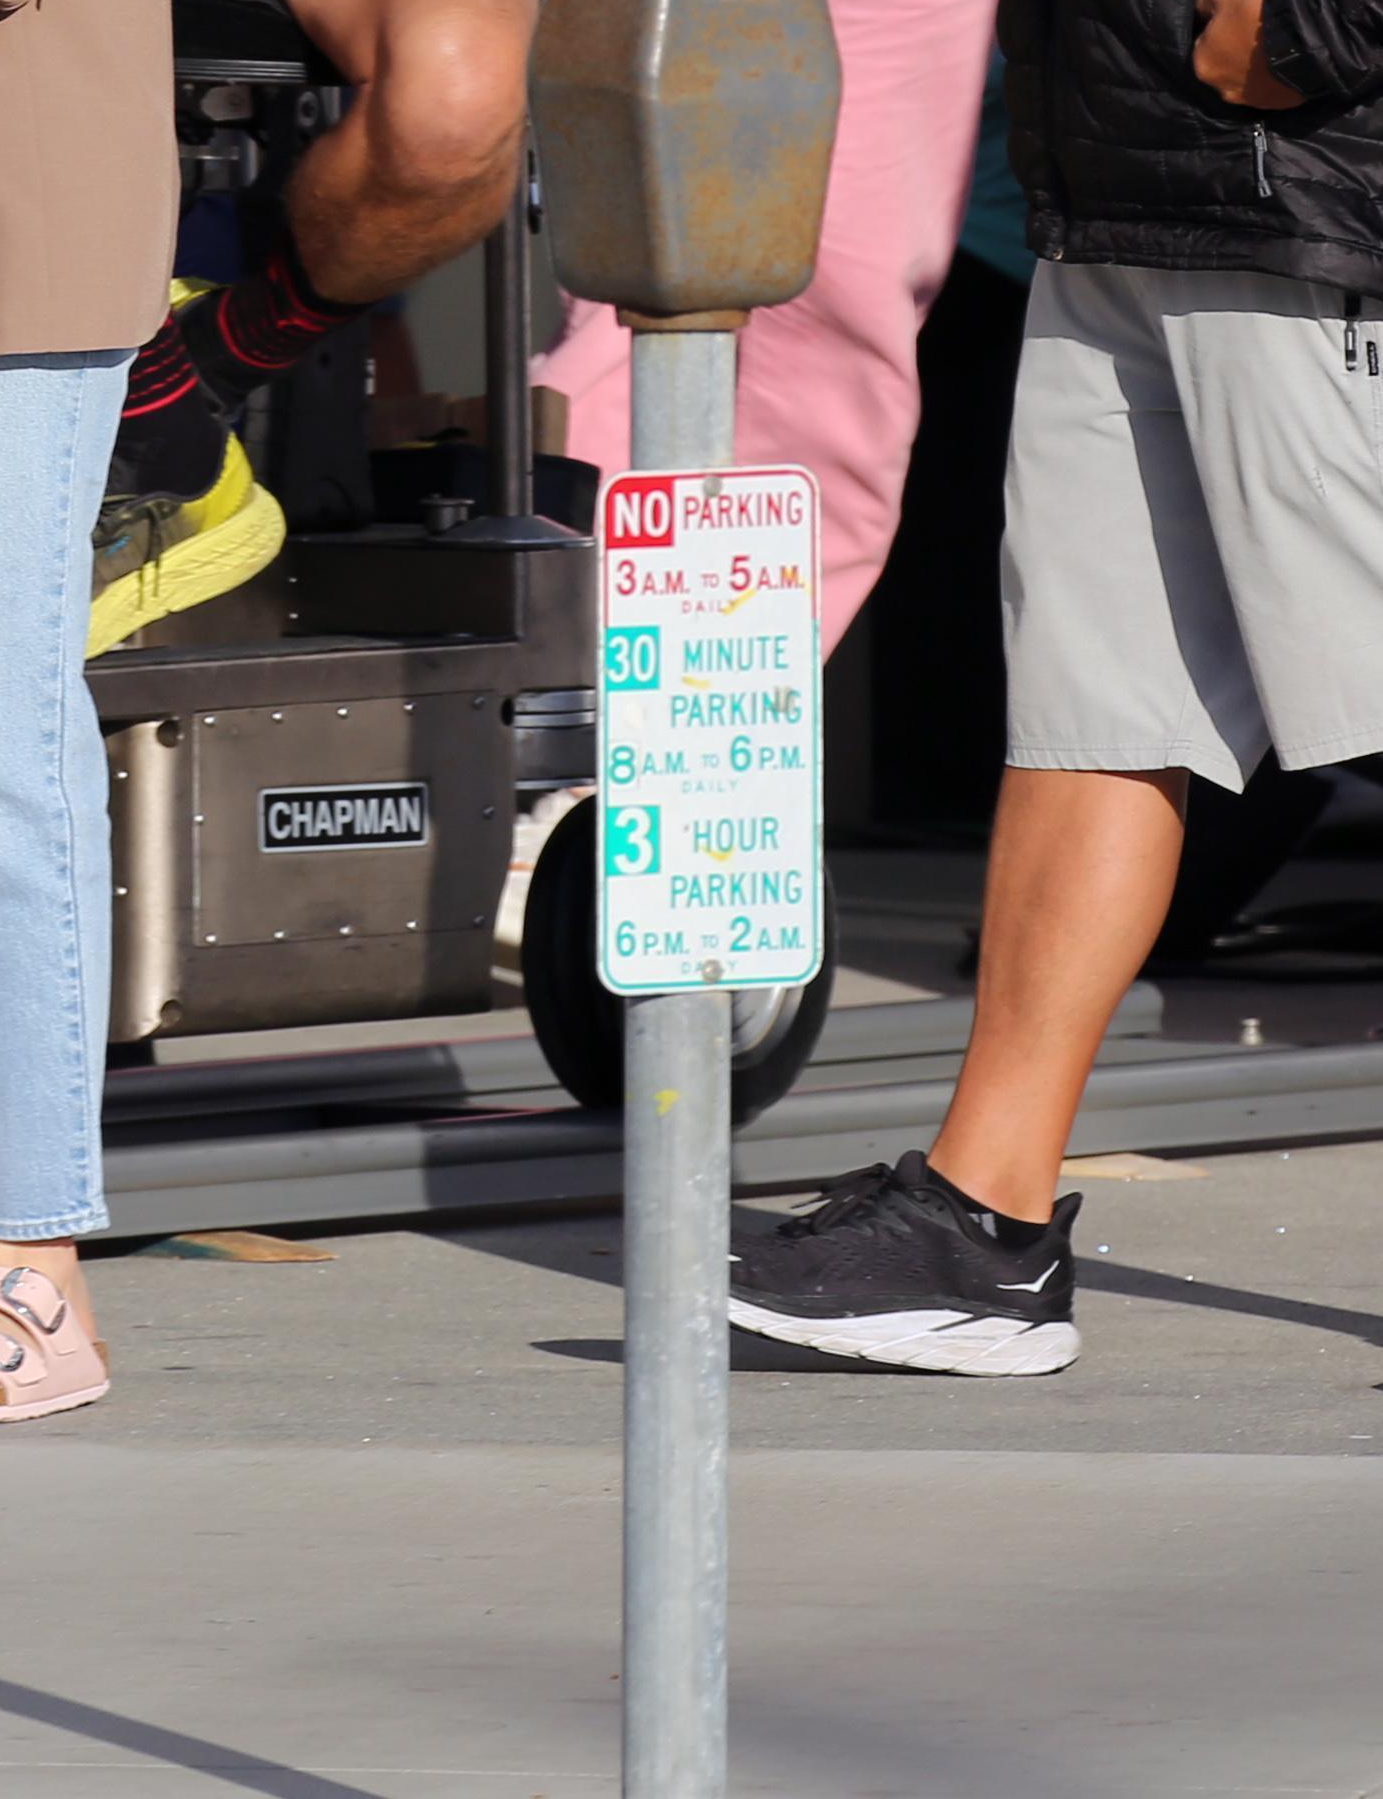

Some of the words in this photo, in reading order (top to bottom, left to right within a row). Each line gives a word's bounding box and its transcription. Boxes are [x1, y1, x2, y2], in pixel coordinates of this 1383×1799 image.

[613, 490, 672, 538] NO
[683, 491, 804, 530] PARKING
[700, 573, 720, 589] TO
[608, 634, 657, 683] 30
[683, 635, 789, 673] MINUTE
[670, 690, 803, 728] PARKING
[701, 753, 721, 768] TO
[681, 779, 739, 794] DAILY
[268, 796, 421, 840] CHAPMAN
[613, 807, 654, 874] 3
[693, 816, 779, 853] HOUR
[670, 870, 803, 909] PARKING
[701, 934, 720, 949] TO
